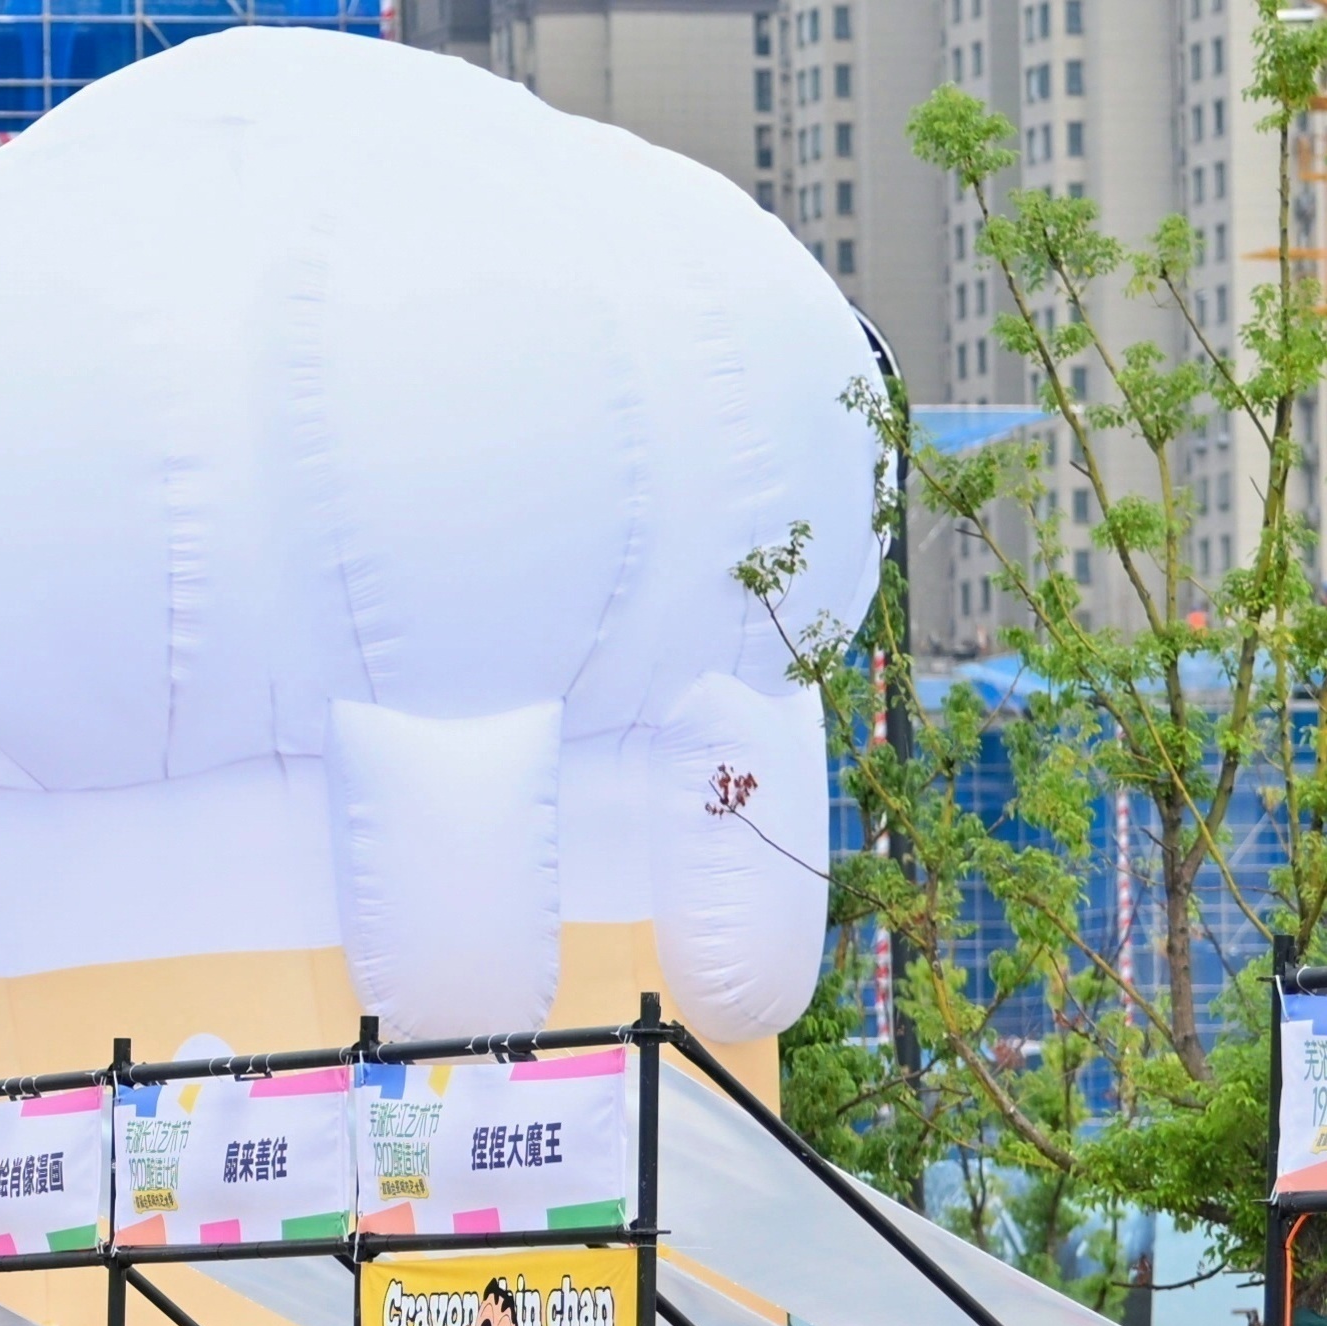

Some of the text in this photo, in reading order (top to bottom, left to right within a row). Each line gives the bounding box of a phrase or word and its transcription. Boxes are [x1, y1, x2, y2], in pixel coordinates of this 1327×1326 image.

[223, 1136, 288, 1184] 扇来善往
[471, 1121, 563, 1171] 捏捏大魔王
